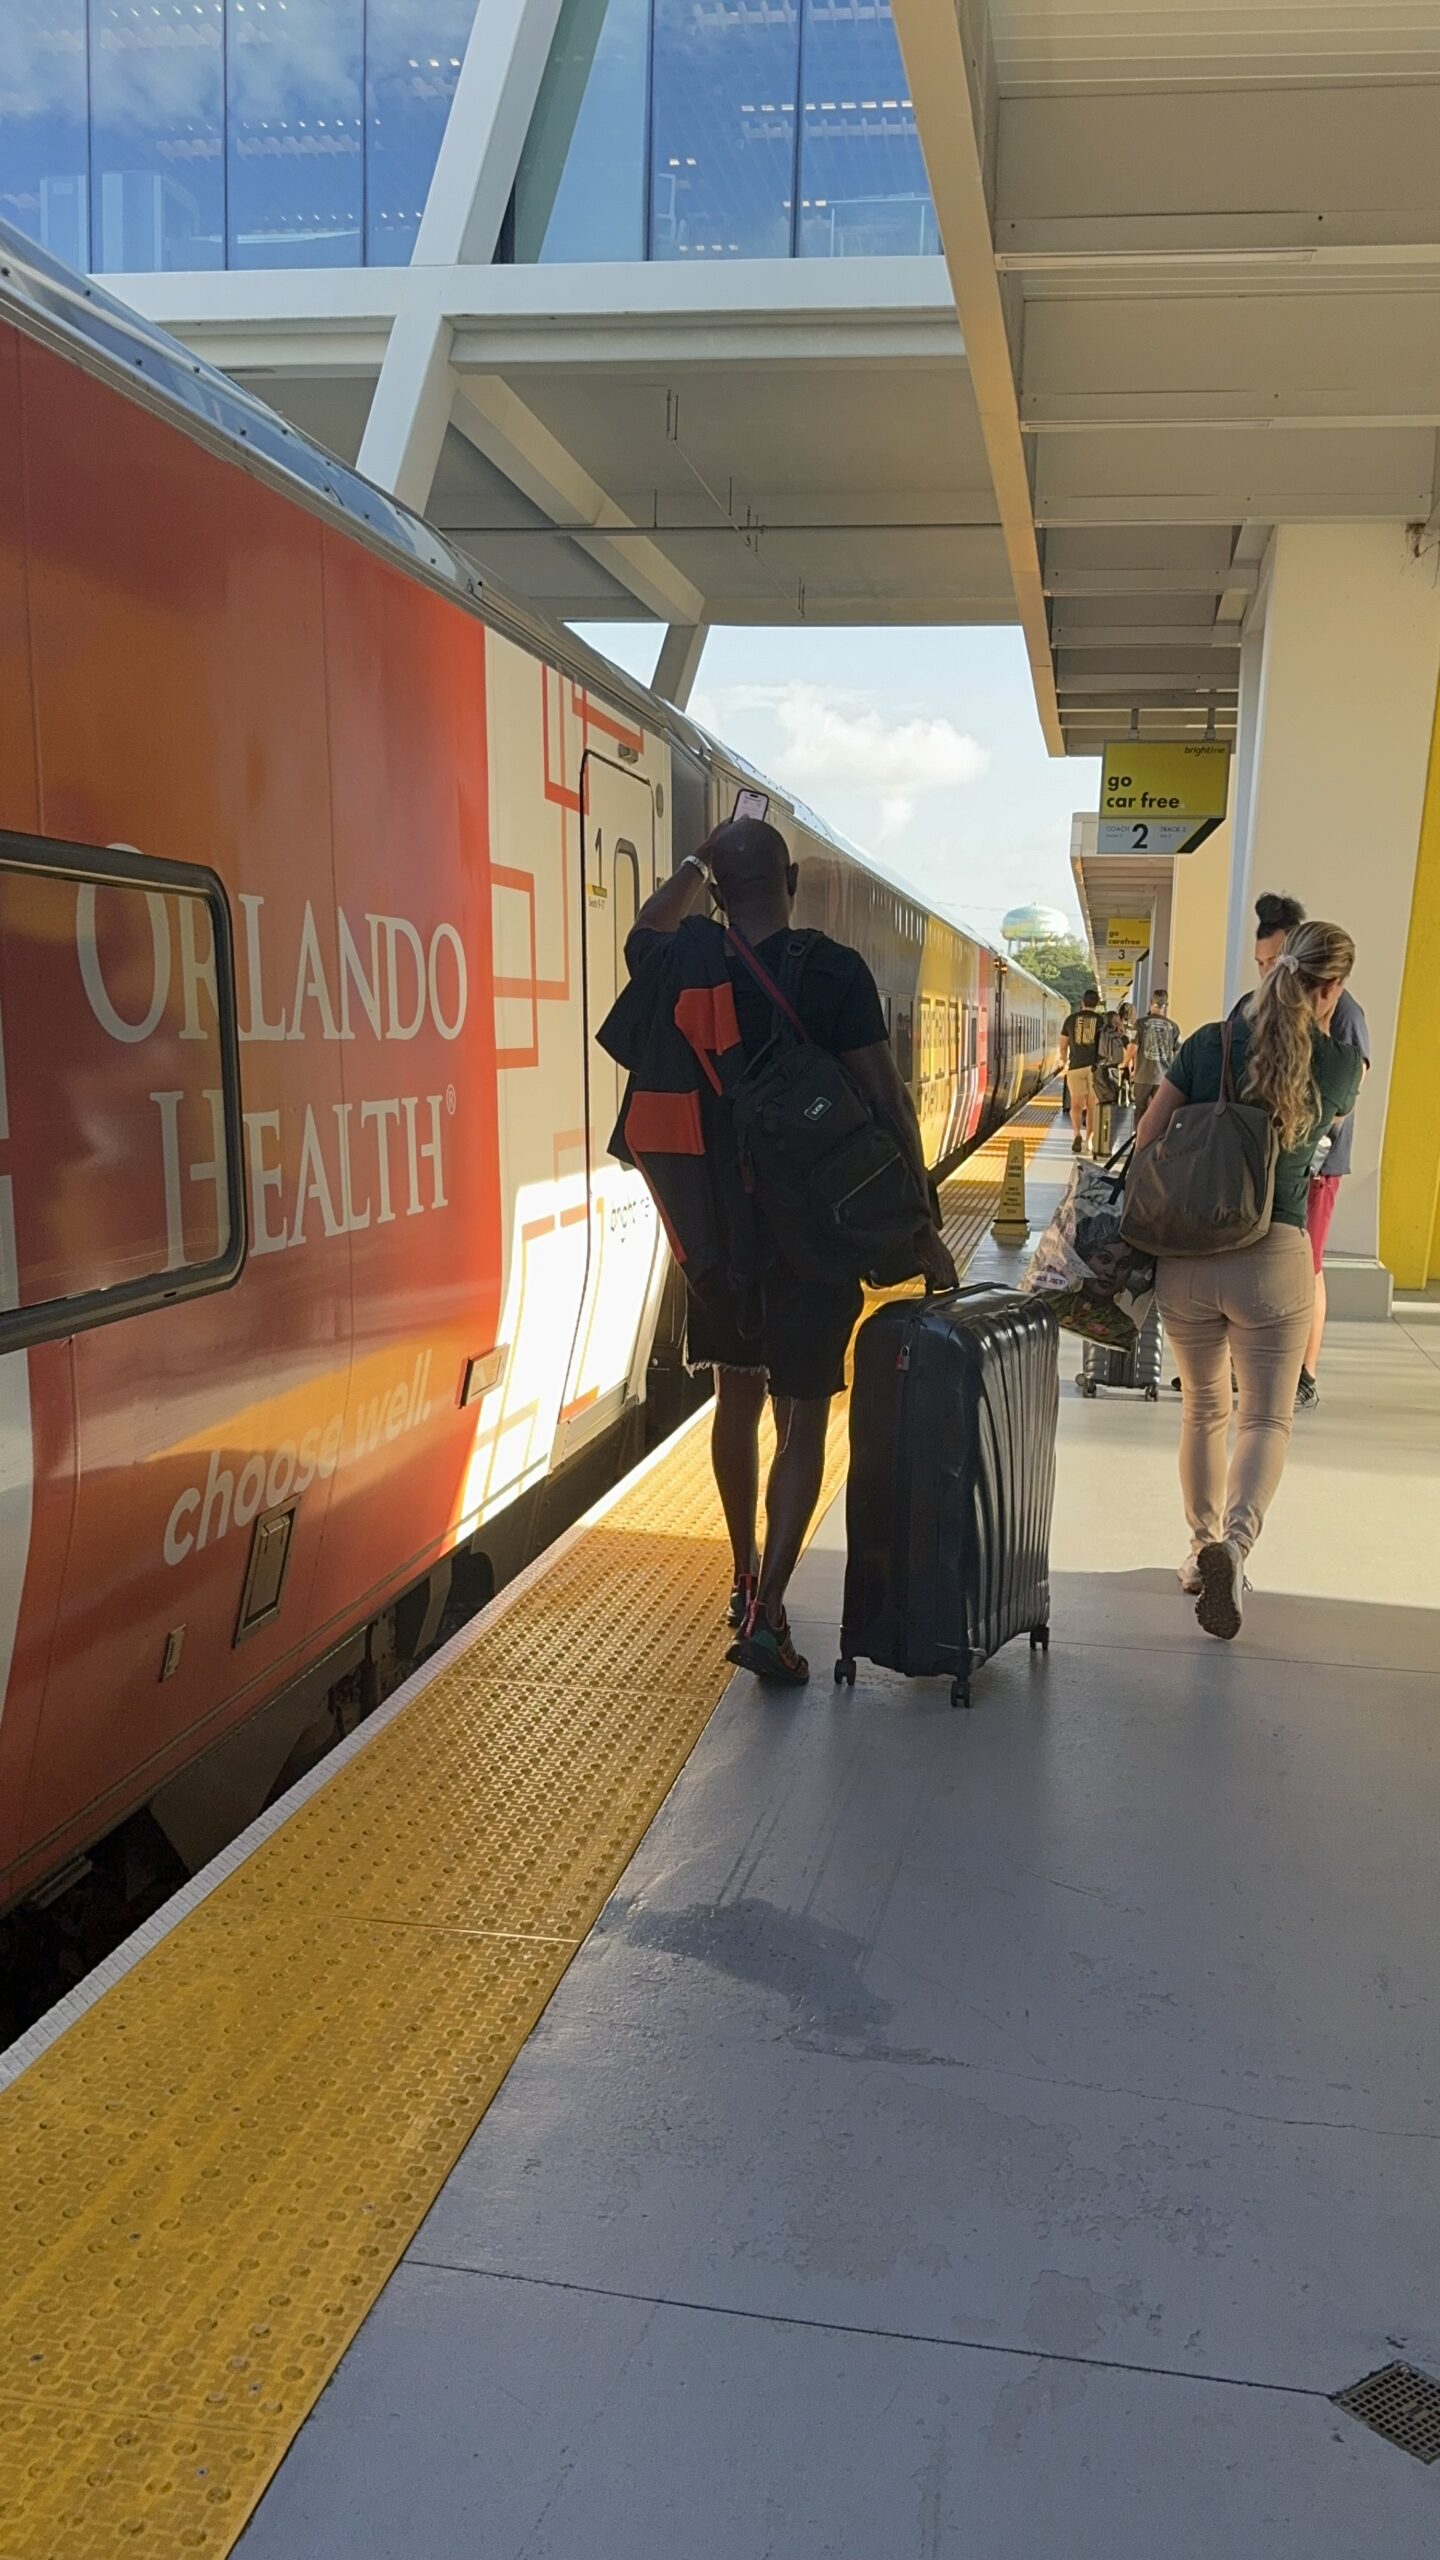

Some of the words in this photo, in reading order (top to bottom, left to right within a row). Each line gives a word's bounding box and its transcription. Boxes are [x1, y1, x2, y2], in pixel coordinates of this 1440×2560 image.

[1184, 746, 1226, 757] brightline
[1107, 775, 1133, 791] go
[1106, 797, 1136, 808] car
[1141, 792, 1180, 808] free
[1131, 823, 1149, 849] 2
[594, 827, 603, 888] 1
[1108, 930, 1120, 938] go
[1108, 937, 1141, 945] carefree
[76, 843, 467, 1044] ORLANDO
[1118, 949, 1126, 960] 3
[163, 1411, 345, 1566] choose
[354, 1348, 433, 1459] well.
